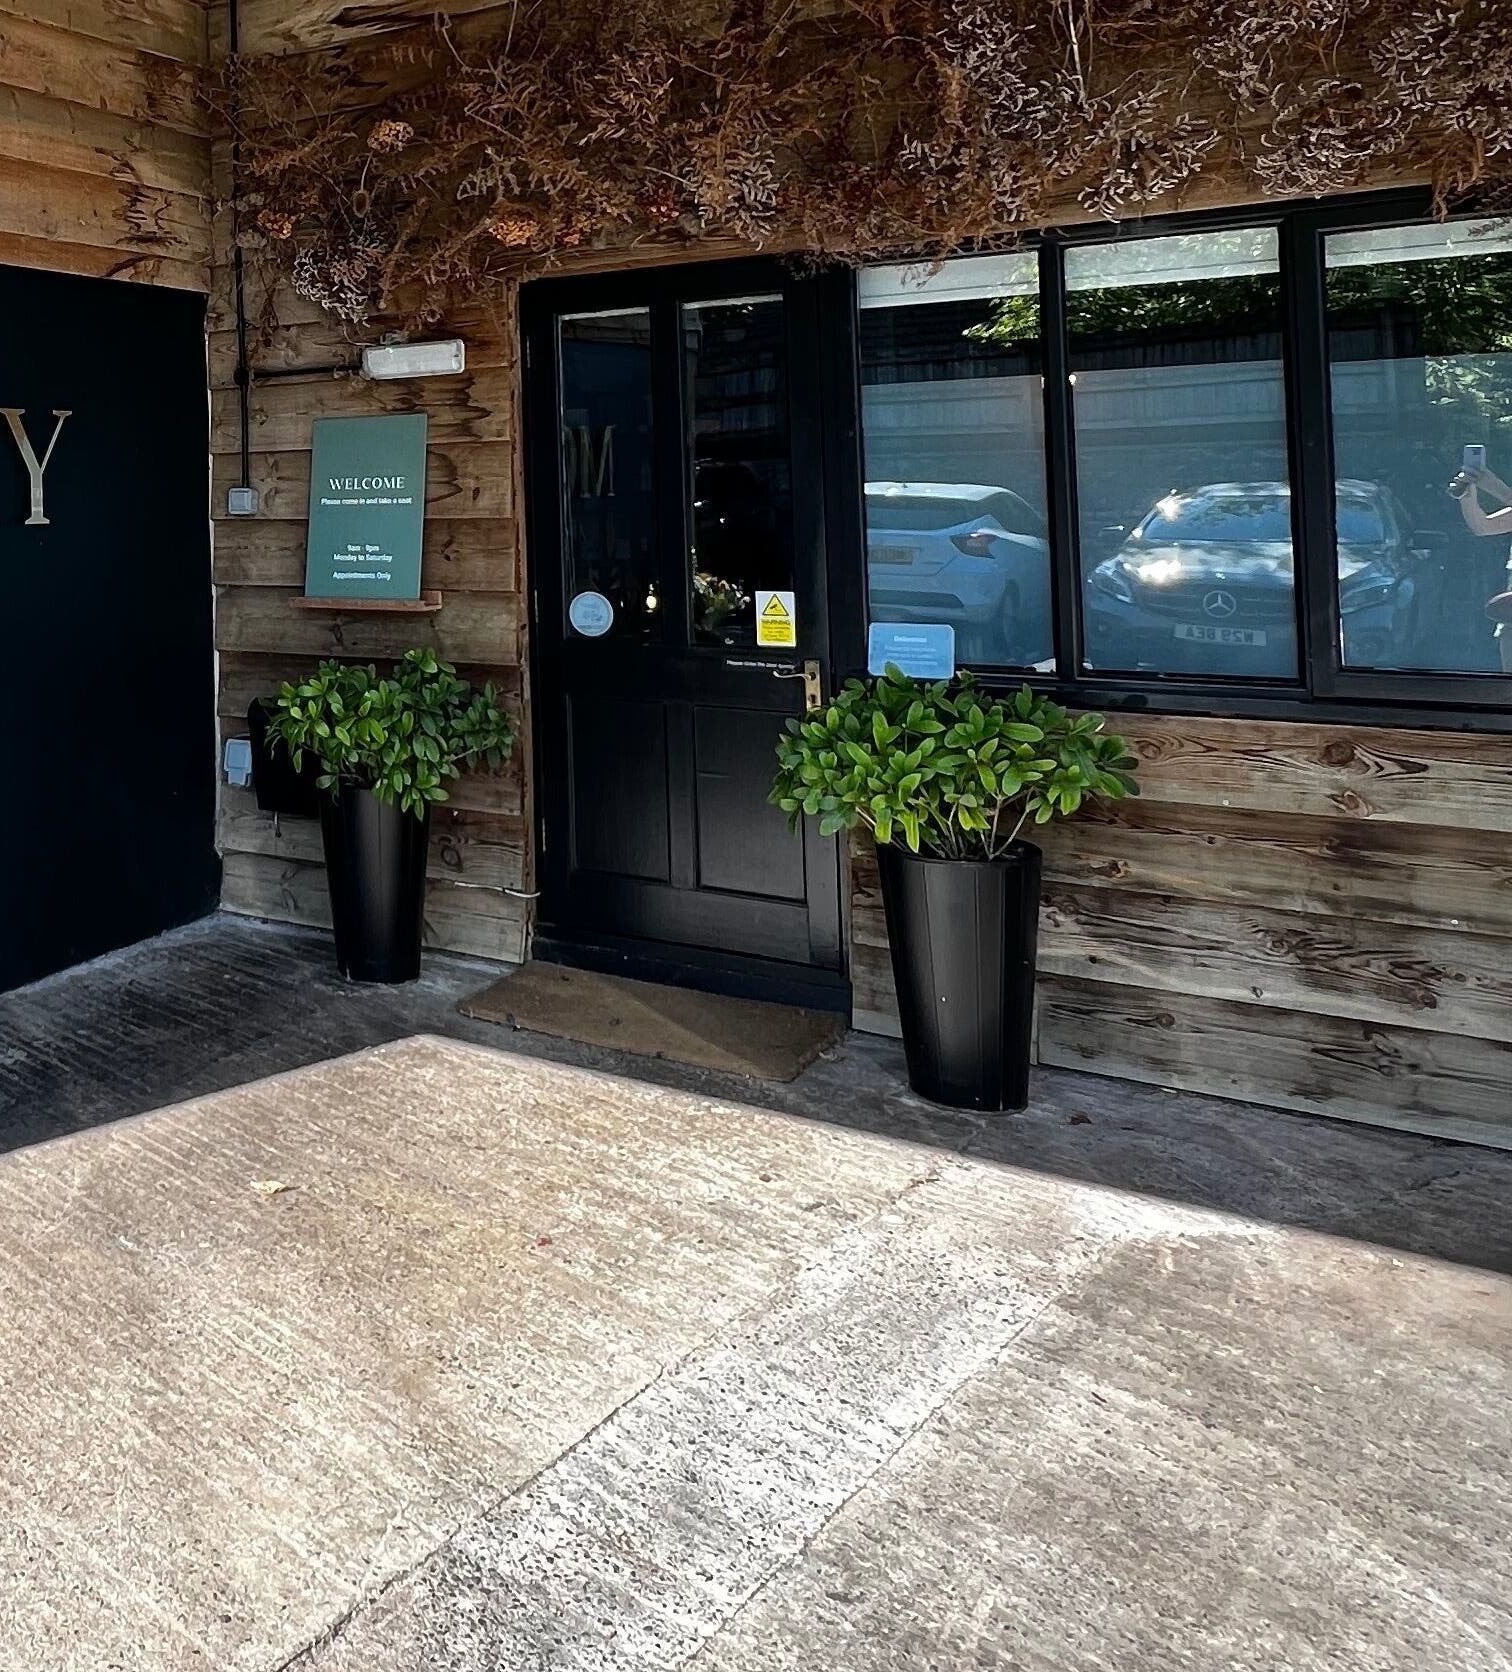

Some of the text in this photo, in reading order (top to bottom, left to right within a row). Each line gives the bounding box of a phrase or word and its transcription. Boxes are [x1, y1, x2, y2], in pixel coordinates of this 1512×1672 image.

[329, 476, 406, 490] WELCOME
[333, 553, 357, 562] Monday
[365, 553, 393, 562] Saturday
[333, 571, 391, 581] Appointments Only
